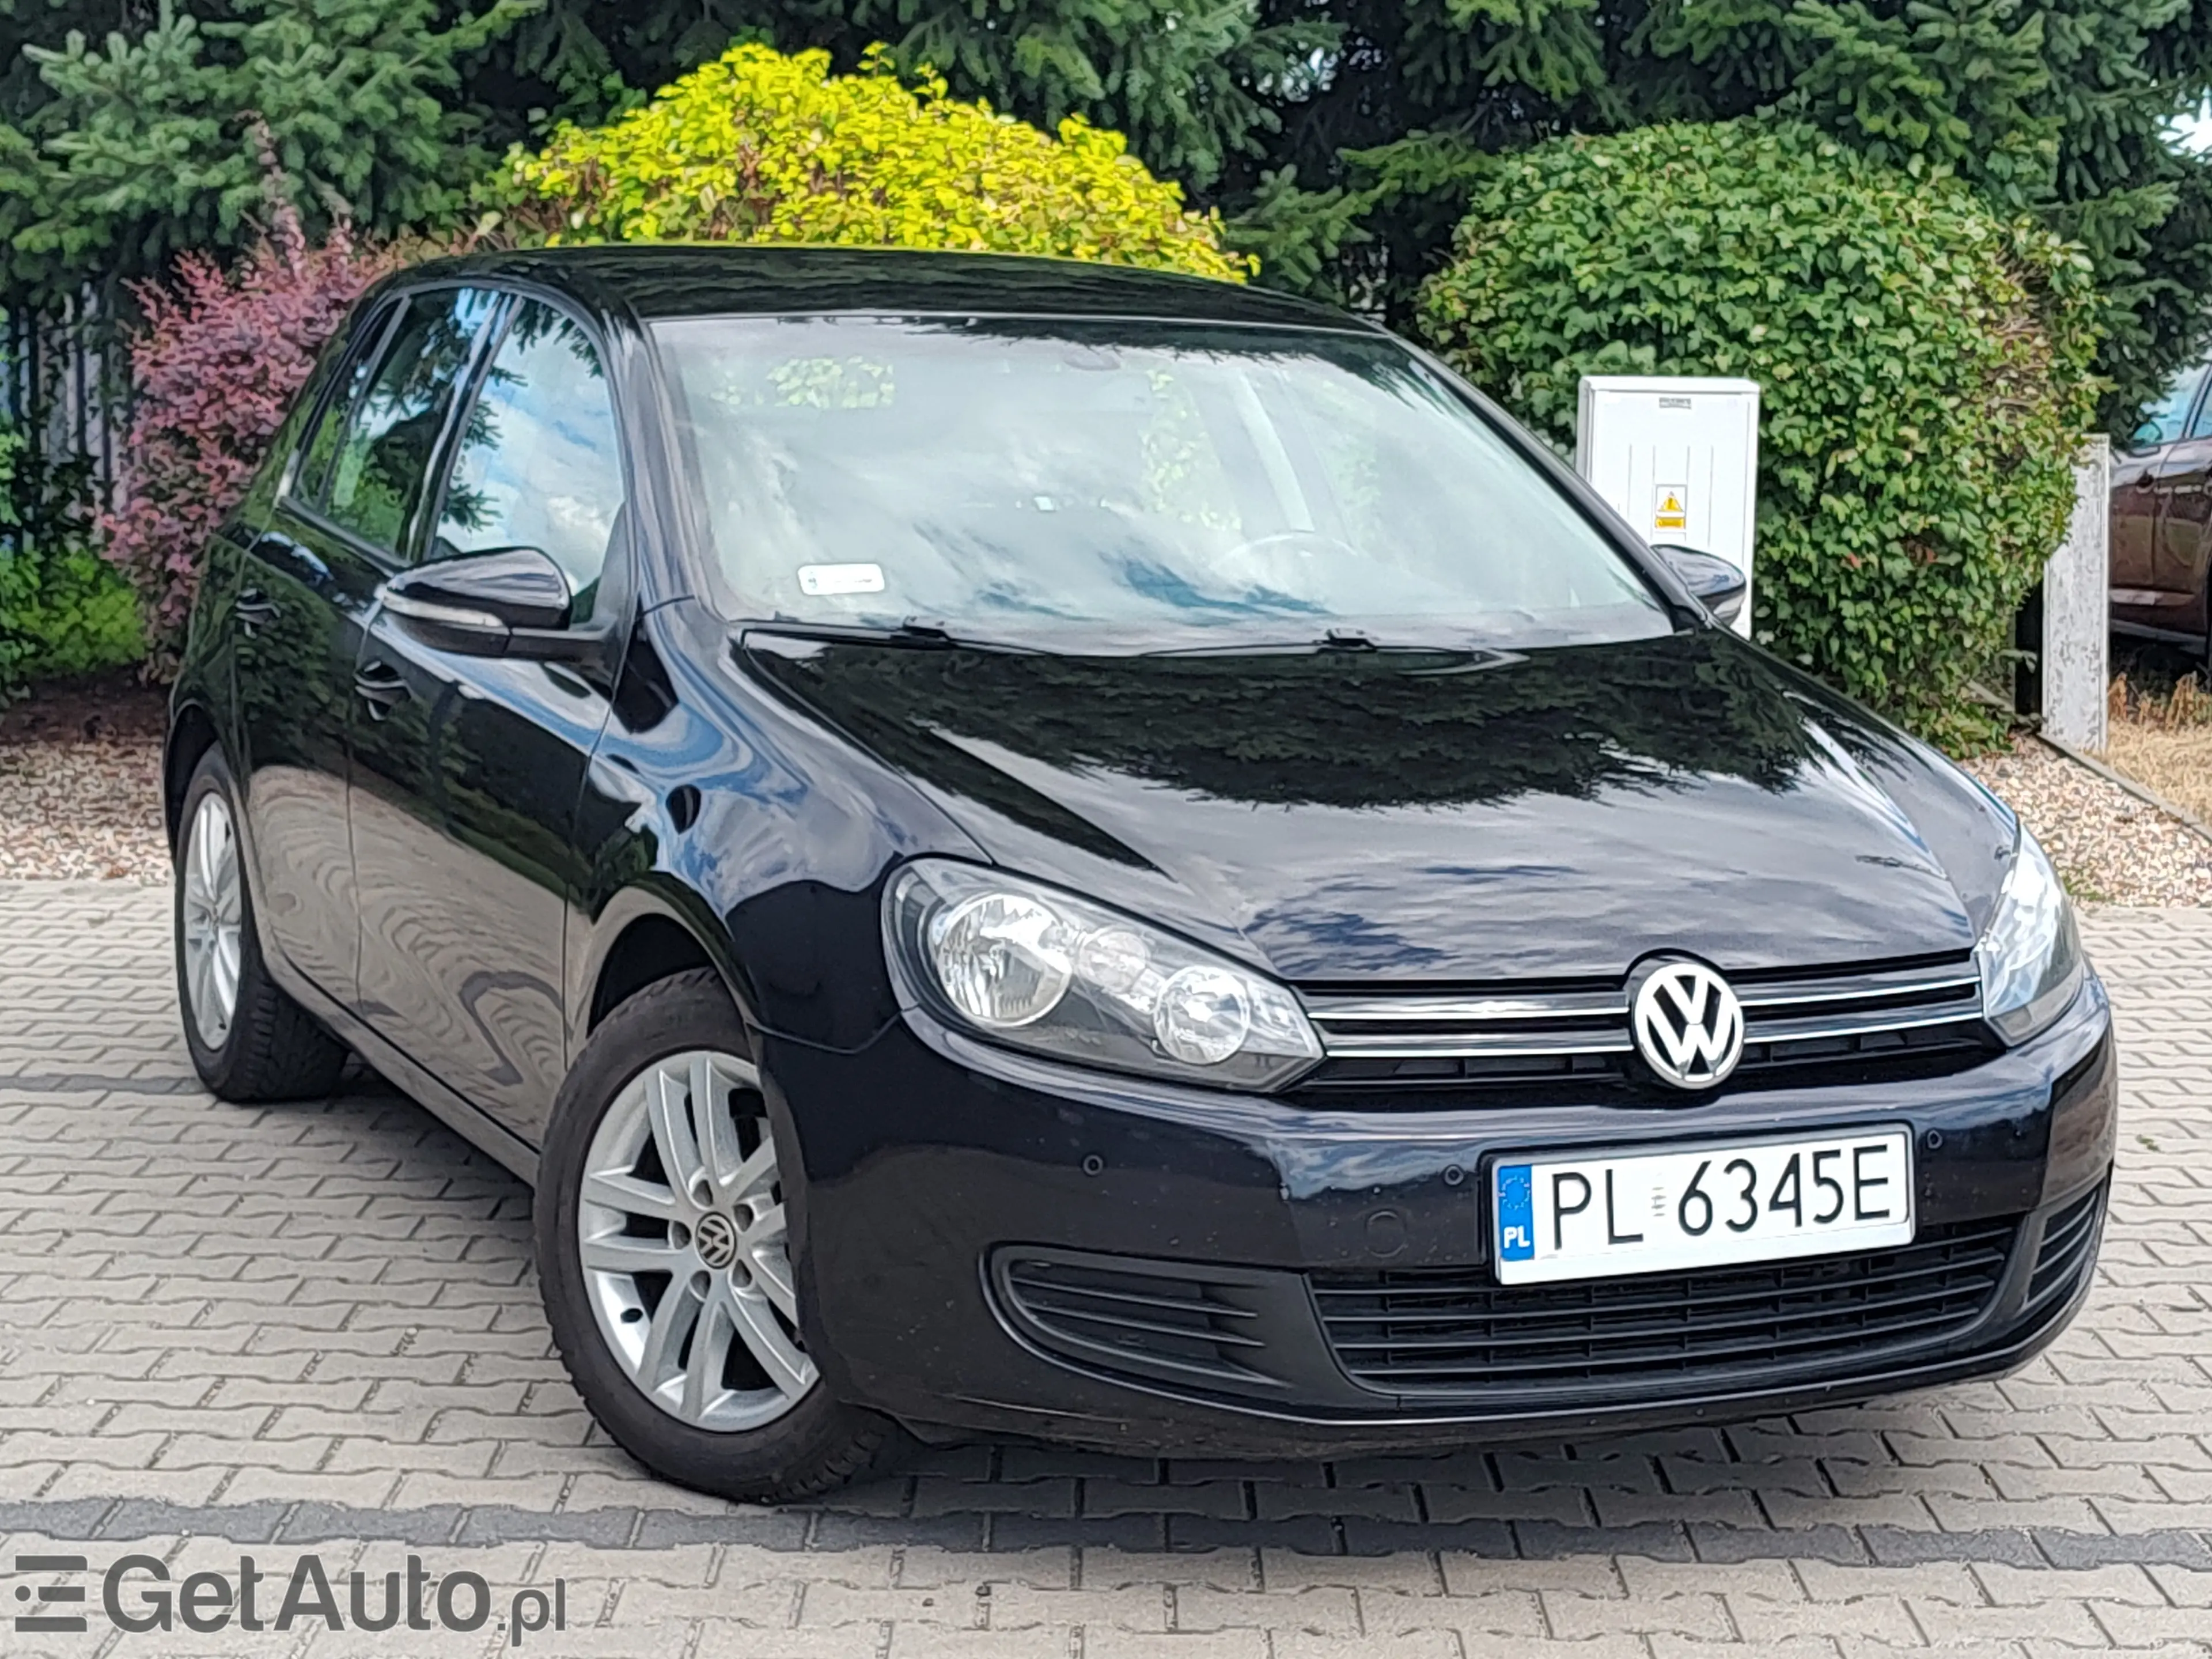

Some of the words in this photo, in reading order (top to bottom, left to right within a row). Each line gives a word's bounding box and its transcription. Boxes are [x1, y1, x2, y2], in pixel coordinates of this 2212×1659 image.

[1635, 963, 1744, 1088] VW
[1503, 1225, 1531, 1249] PL
[1552, 1168, 1643, 1250] PL
[1677, 1143, 1891, 1237] 6345E
